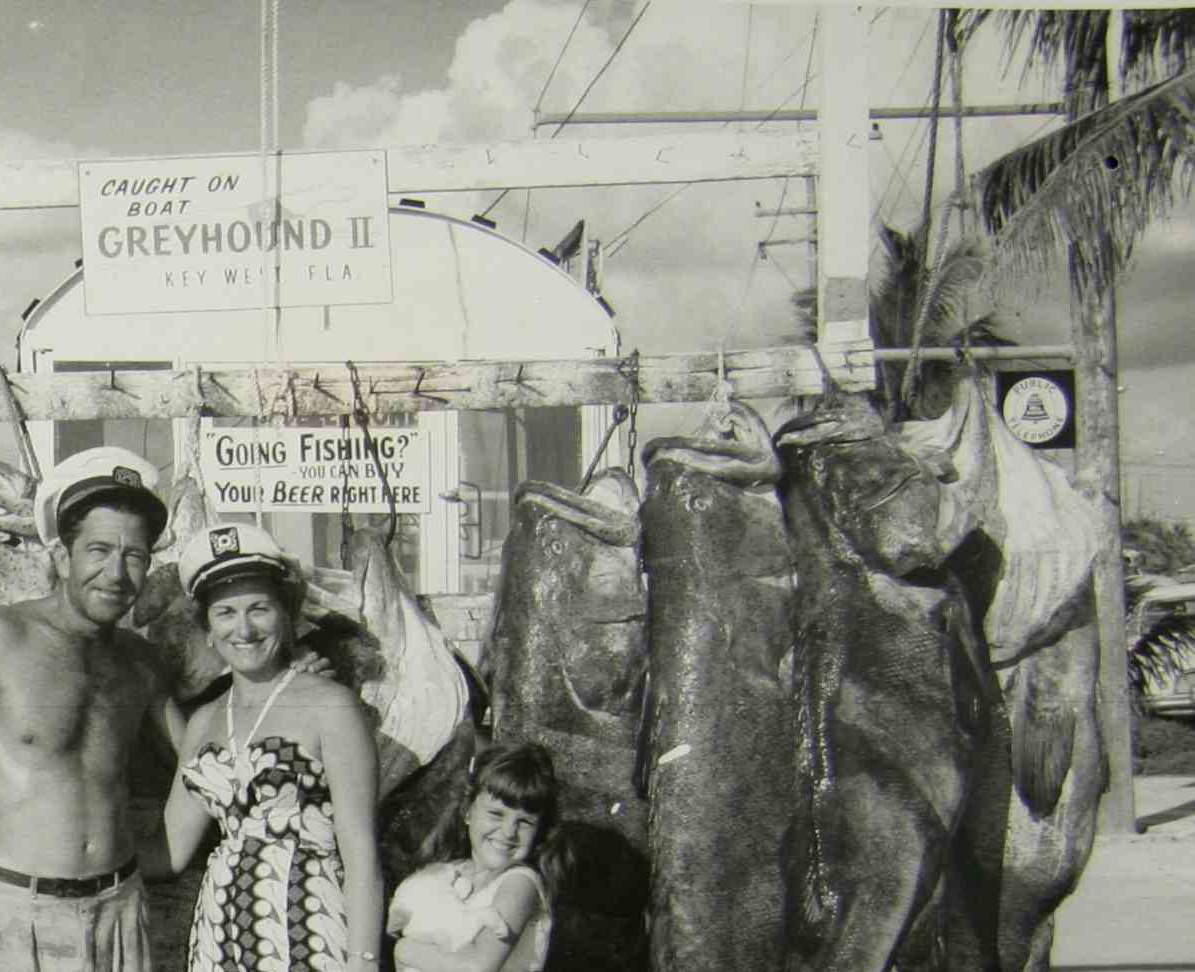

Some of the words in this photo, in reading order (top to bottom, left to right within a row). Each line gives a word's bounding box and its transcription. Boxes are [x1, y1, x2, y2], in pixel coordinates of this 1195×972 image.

[100, 175, 197, 196] CAUGHT
[207, 175, 240, 192] ON
[126, 199, 192, 217] BOAT
[97, 217, 332, 258] GREYHOUND
[347, 215, 374, 249] II
[165, 269, 208, 287] KEY
[224, 266, 282, 286] WET
[1013, 378, 1056, 393] PUBLIC
[1007, 416, 1064, 441] TELEPHONE
[330, 463, 359, 479] CAN
[272, 480, 325, 504] BEER
